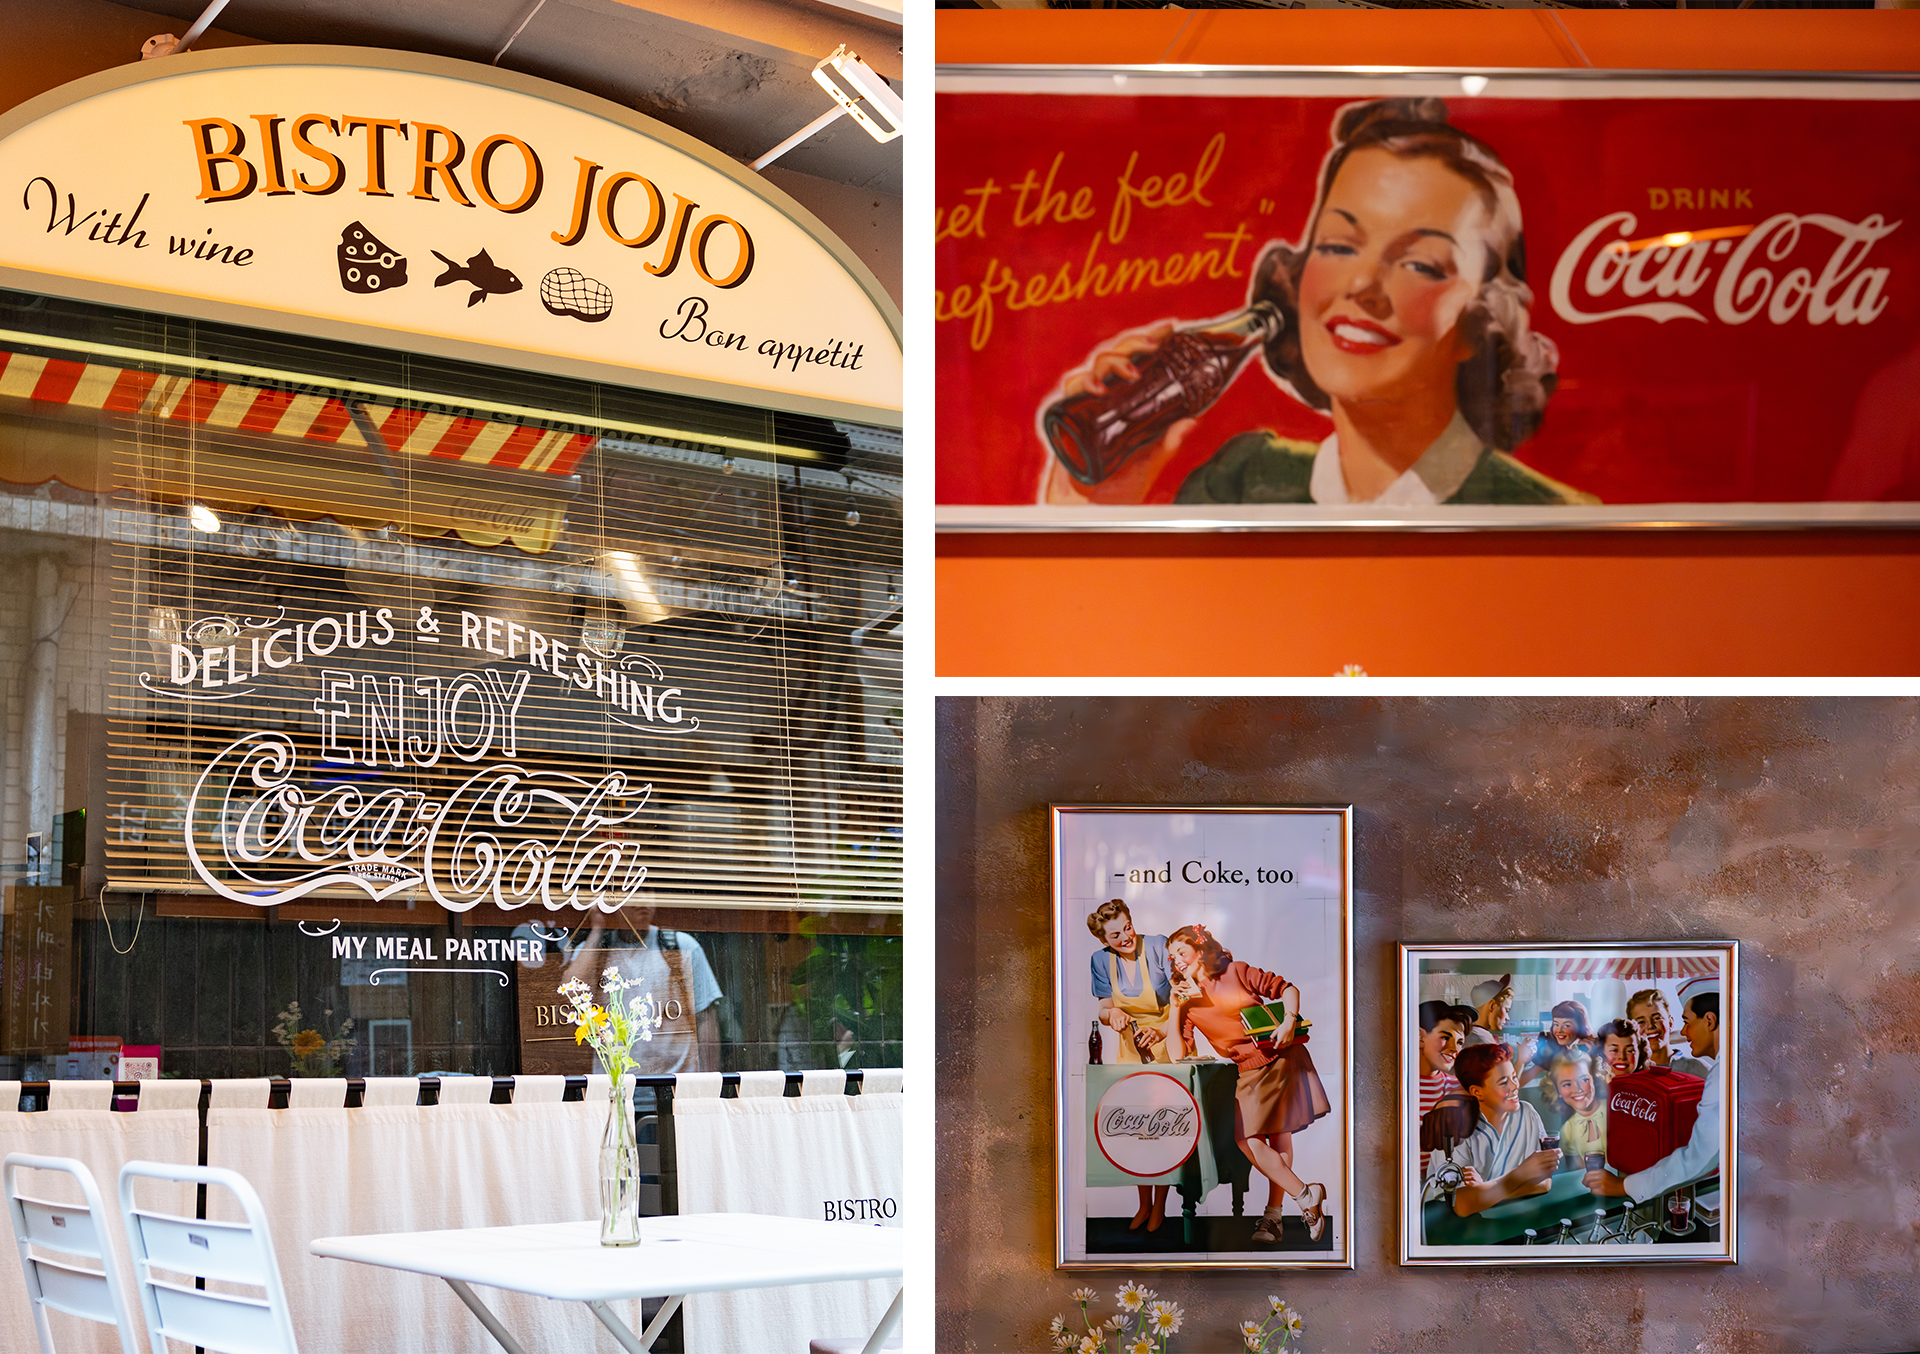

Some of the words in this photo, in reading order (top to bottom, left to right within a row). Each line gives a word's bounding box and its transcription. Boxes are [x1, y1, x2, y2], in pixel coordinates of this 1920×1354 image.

[23, 176, 150, 249] With
[169, 228, 254, 266] wine
[182, 113, 544, 214] BISTRO
[550, 156, 755, 289] JOJO
[1010, 151, 1096, 228] the
[1109, 132, 1226, 244] feel
[1647, 187, 1753, 210] DRINK
[1549, 211, 1903, 325] Coca-Cola
[659, 297, 748, 351] Bon
[758, 339, 865, 372] appétit
[170, 607, 395, 688] DELICIOUS
[415, 605, 441, 642] &
[461, 611, 683, 724] REFRESHING
[314, 669, 531, 768] ENJOY
[185, 731, 653, 913] Coca-Cola
[348, 863, 379, 873] TRADE
[382, 864, 409, 879] MARK
[1181, 860, 1250, 886] Coke,
[1257, 865, 1294, 884] too
[332, 936, 367, 959] MY
[376, 936, 438, 961] MEAL
[445, 938, 543, 962] PARTNER
[1102, 1107, 1193, 1136] Coca-Cola
[1611, 1092, 1657, 1122] Coca-Cola
[823, 1197, 897, 1222] BISTRO
